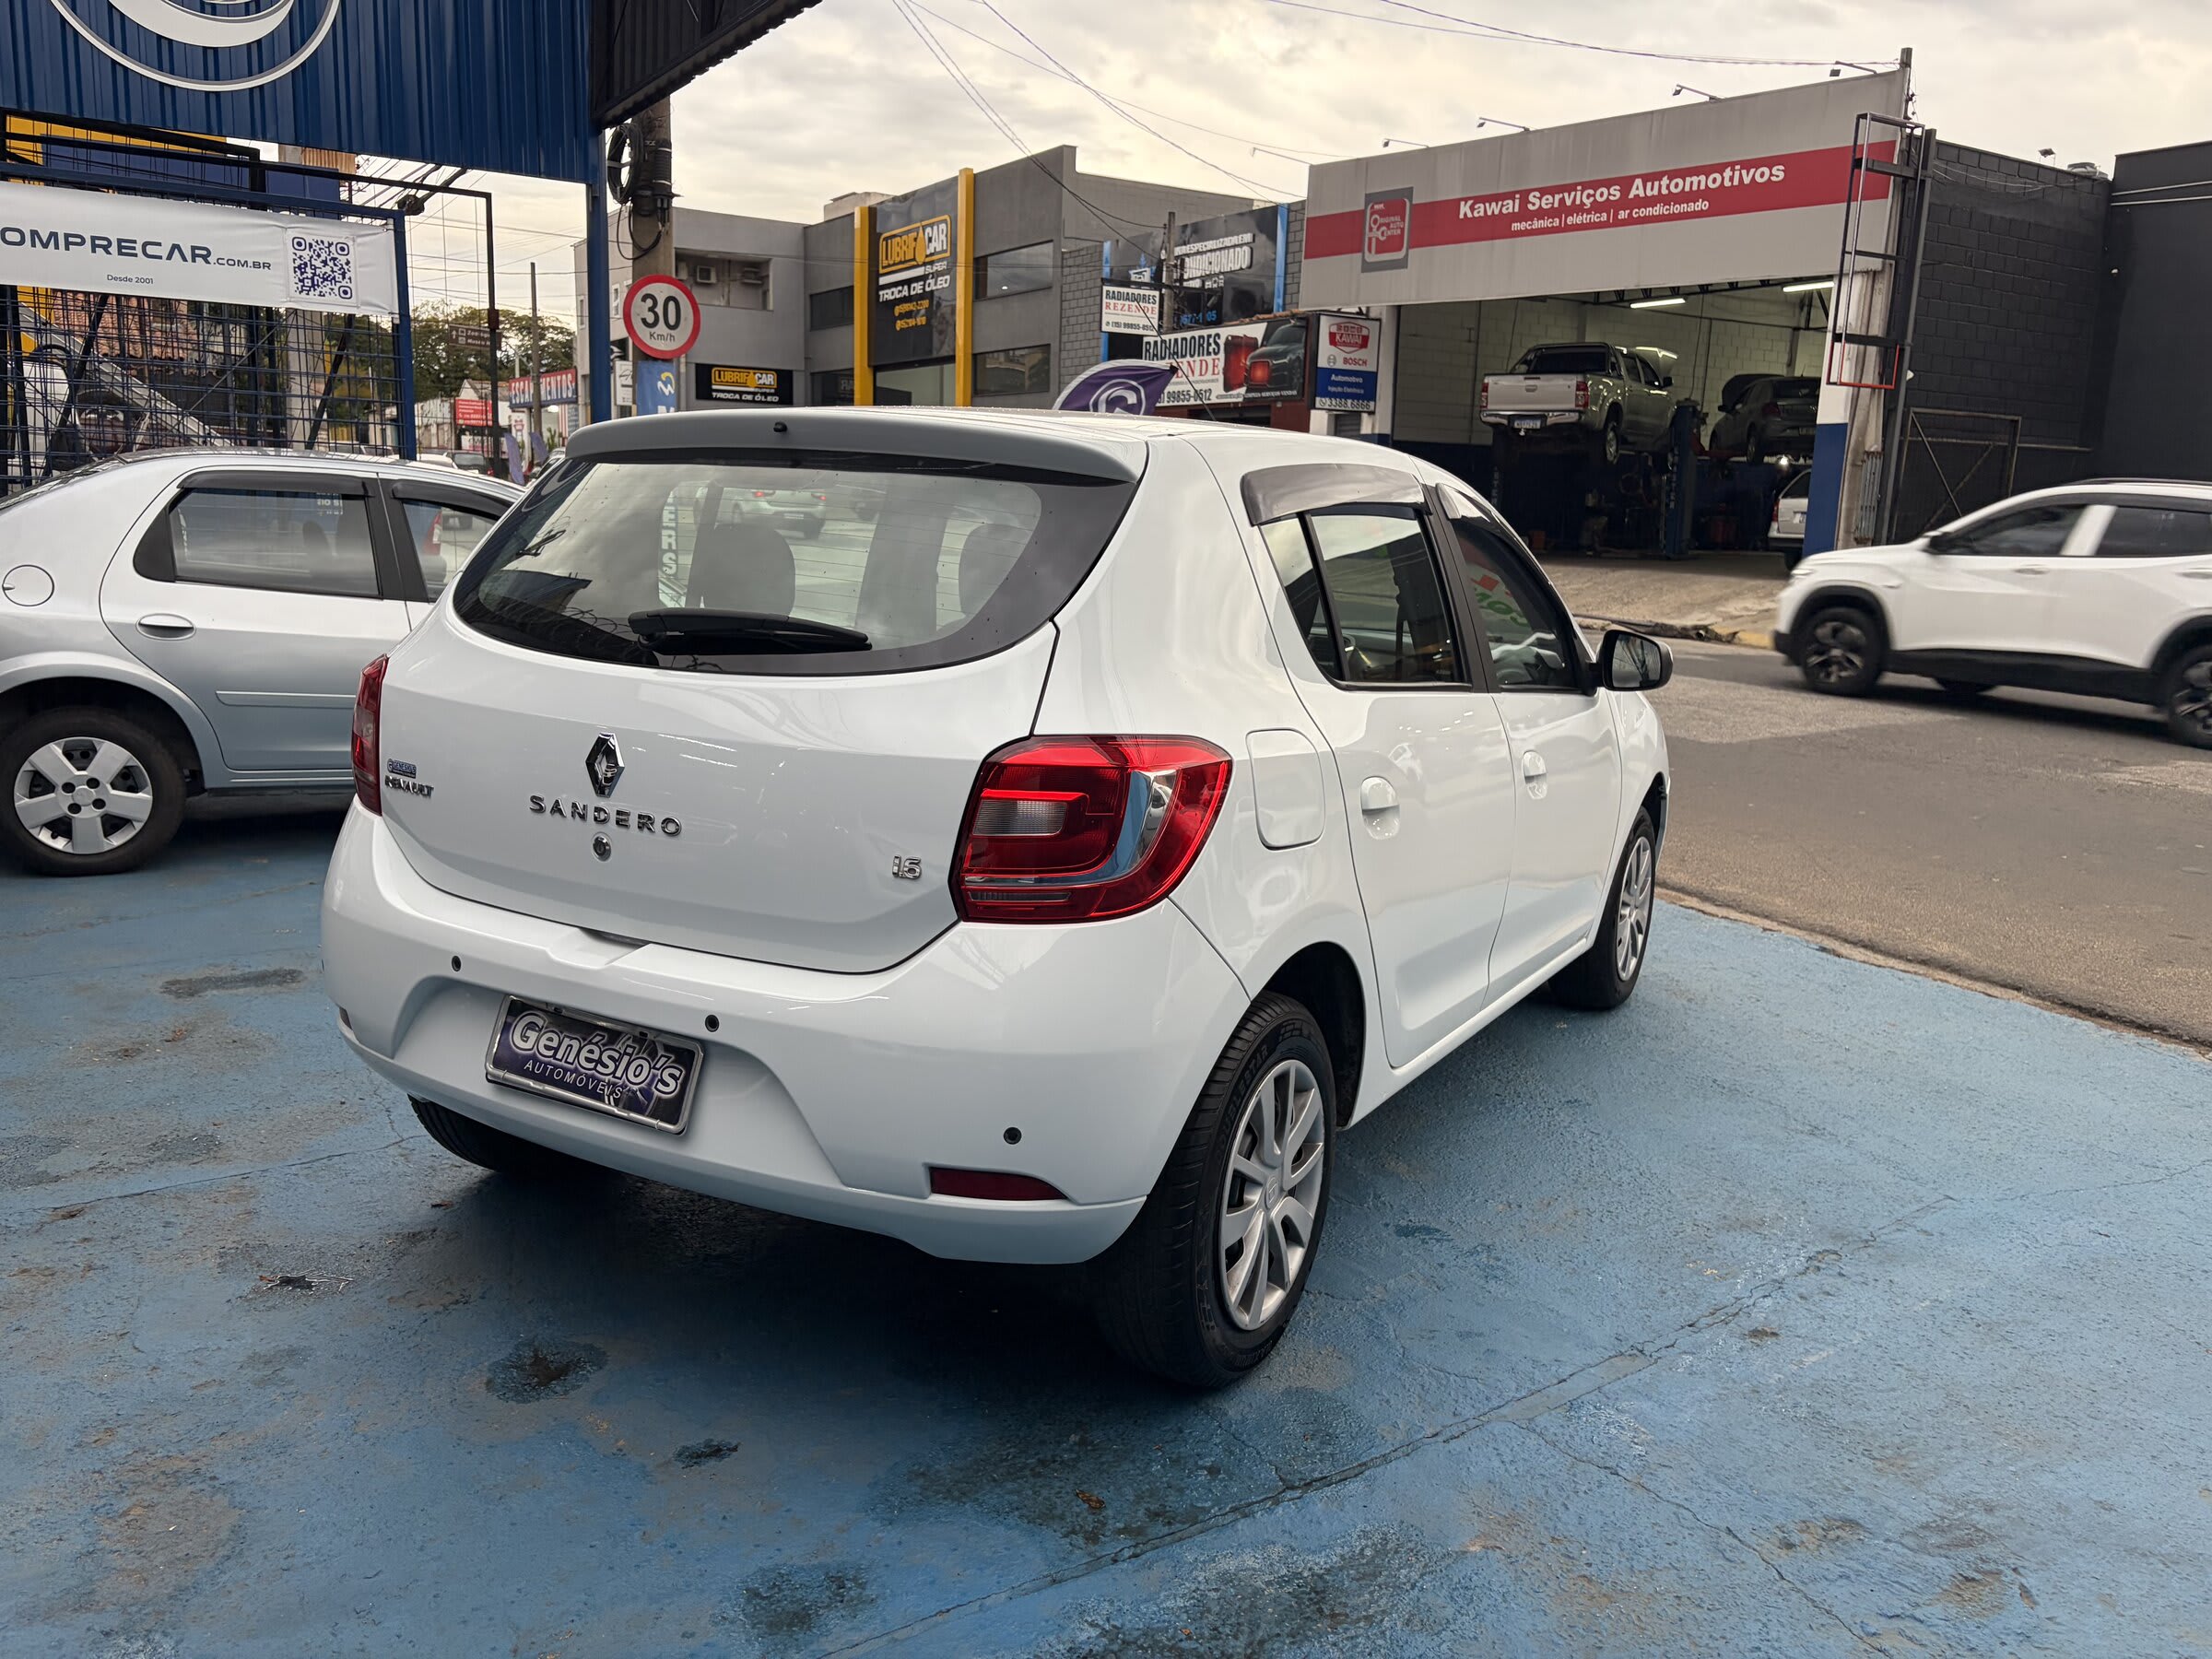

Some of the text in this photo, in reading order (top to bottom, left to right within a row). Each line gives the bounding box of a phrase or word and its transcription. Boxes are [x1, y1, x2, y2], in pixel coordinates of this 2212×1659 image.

[1458, 163, 1786, 219] Kawai Serviços Automotivos
[1511, 199, 1710, 231] mecânica elétrica ar condicionado
[0, 225, 272, 271] OMPRECAR.COM.BR
[1182, 245, 1252, 280] ONDICIONADO
[107, 274, 154, 285] Desde 2001
[878, 275, 950, 302] TROCA DE ÓLEO
[1105, 289, 1157, 305] RADIADORES
[1105, 301, 1157, 315] REZENDE
[641, 293, 681, 331] 30
[649, 331, 676, 343] Km/h
[1144, 333, 1221, 361] RADIADORES
[1335, 333, 1362, 345] KAWAI
[1169, 358, 1220, 379] ENDE
[1343, 357, 1368, 367] BOSCH
[512, 372, 573, 405] ESCAPMENTOS
[712, 392, 740, 400] TROCA
[755, 394, 780, 403] ÓLEO
[384, 775, 434, 797] RENAULT
[529, 794, 683, 837] SANDERO
[512, 1012, 684, 1095] Genésio's
[524, 1059, 623, 1099] AUTOMÓVEIS
